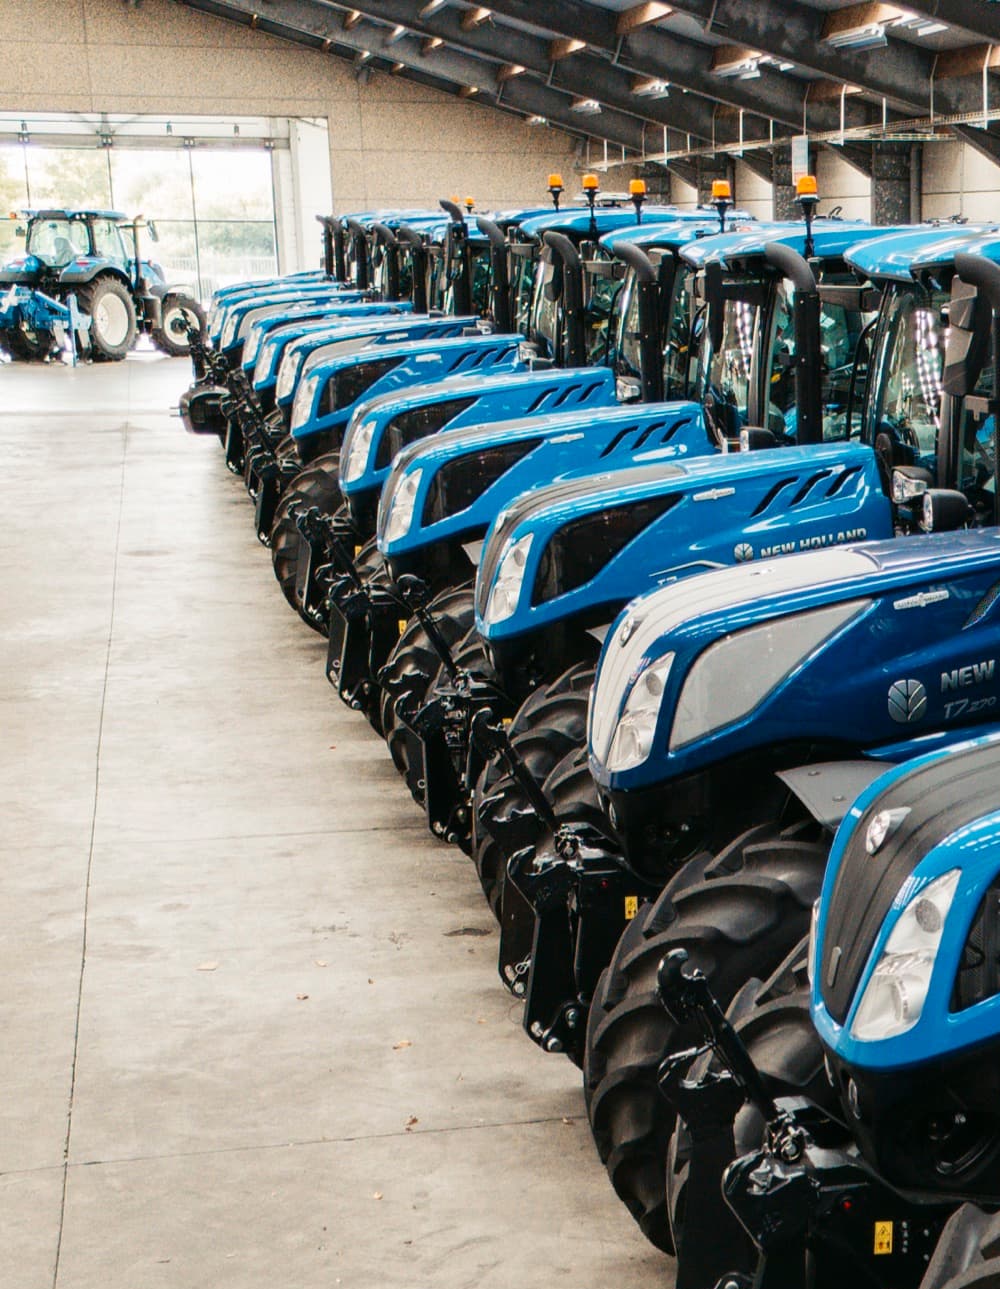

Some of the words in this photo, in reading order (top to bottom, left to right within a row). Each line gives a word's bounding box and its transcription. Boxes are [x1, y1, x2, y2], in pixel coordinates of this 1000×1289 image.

[760, 541, 796, 558] NEW
[799, 527, 867, 549] HOLLAND
[941, 659, 996, 692] NEW
